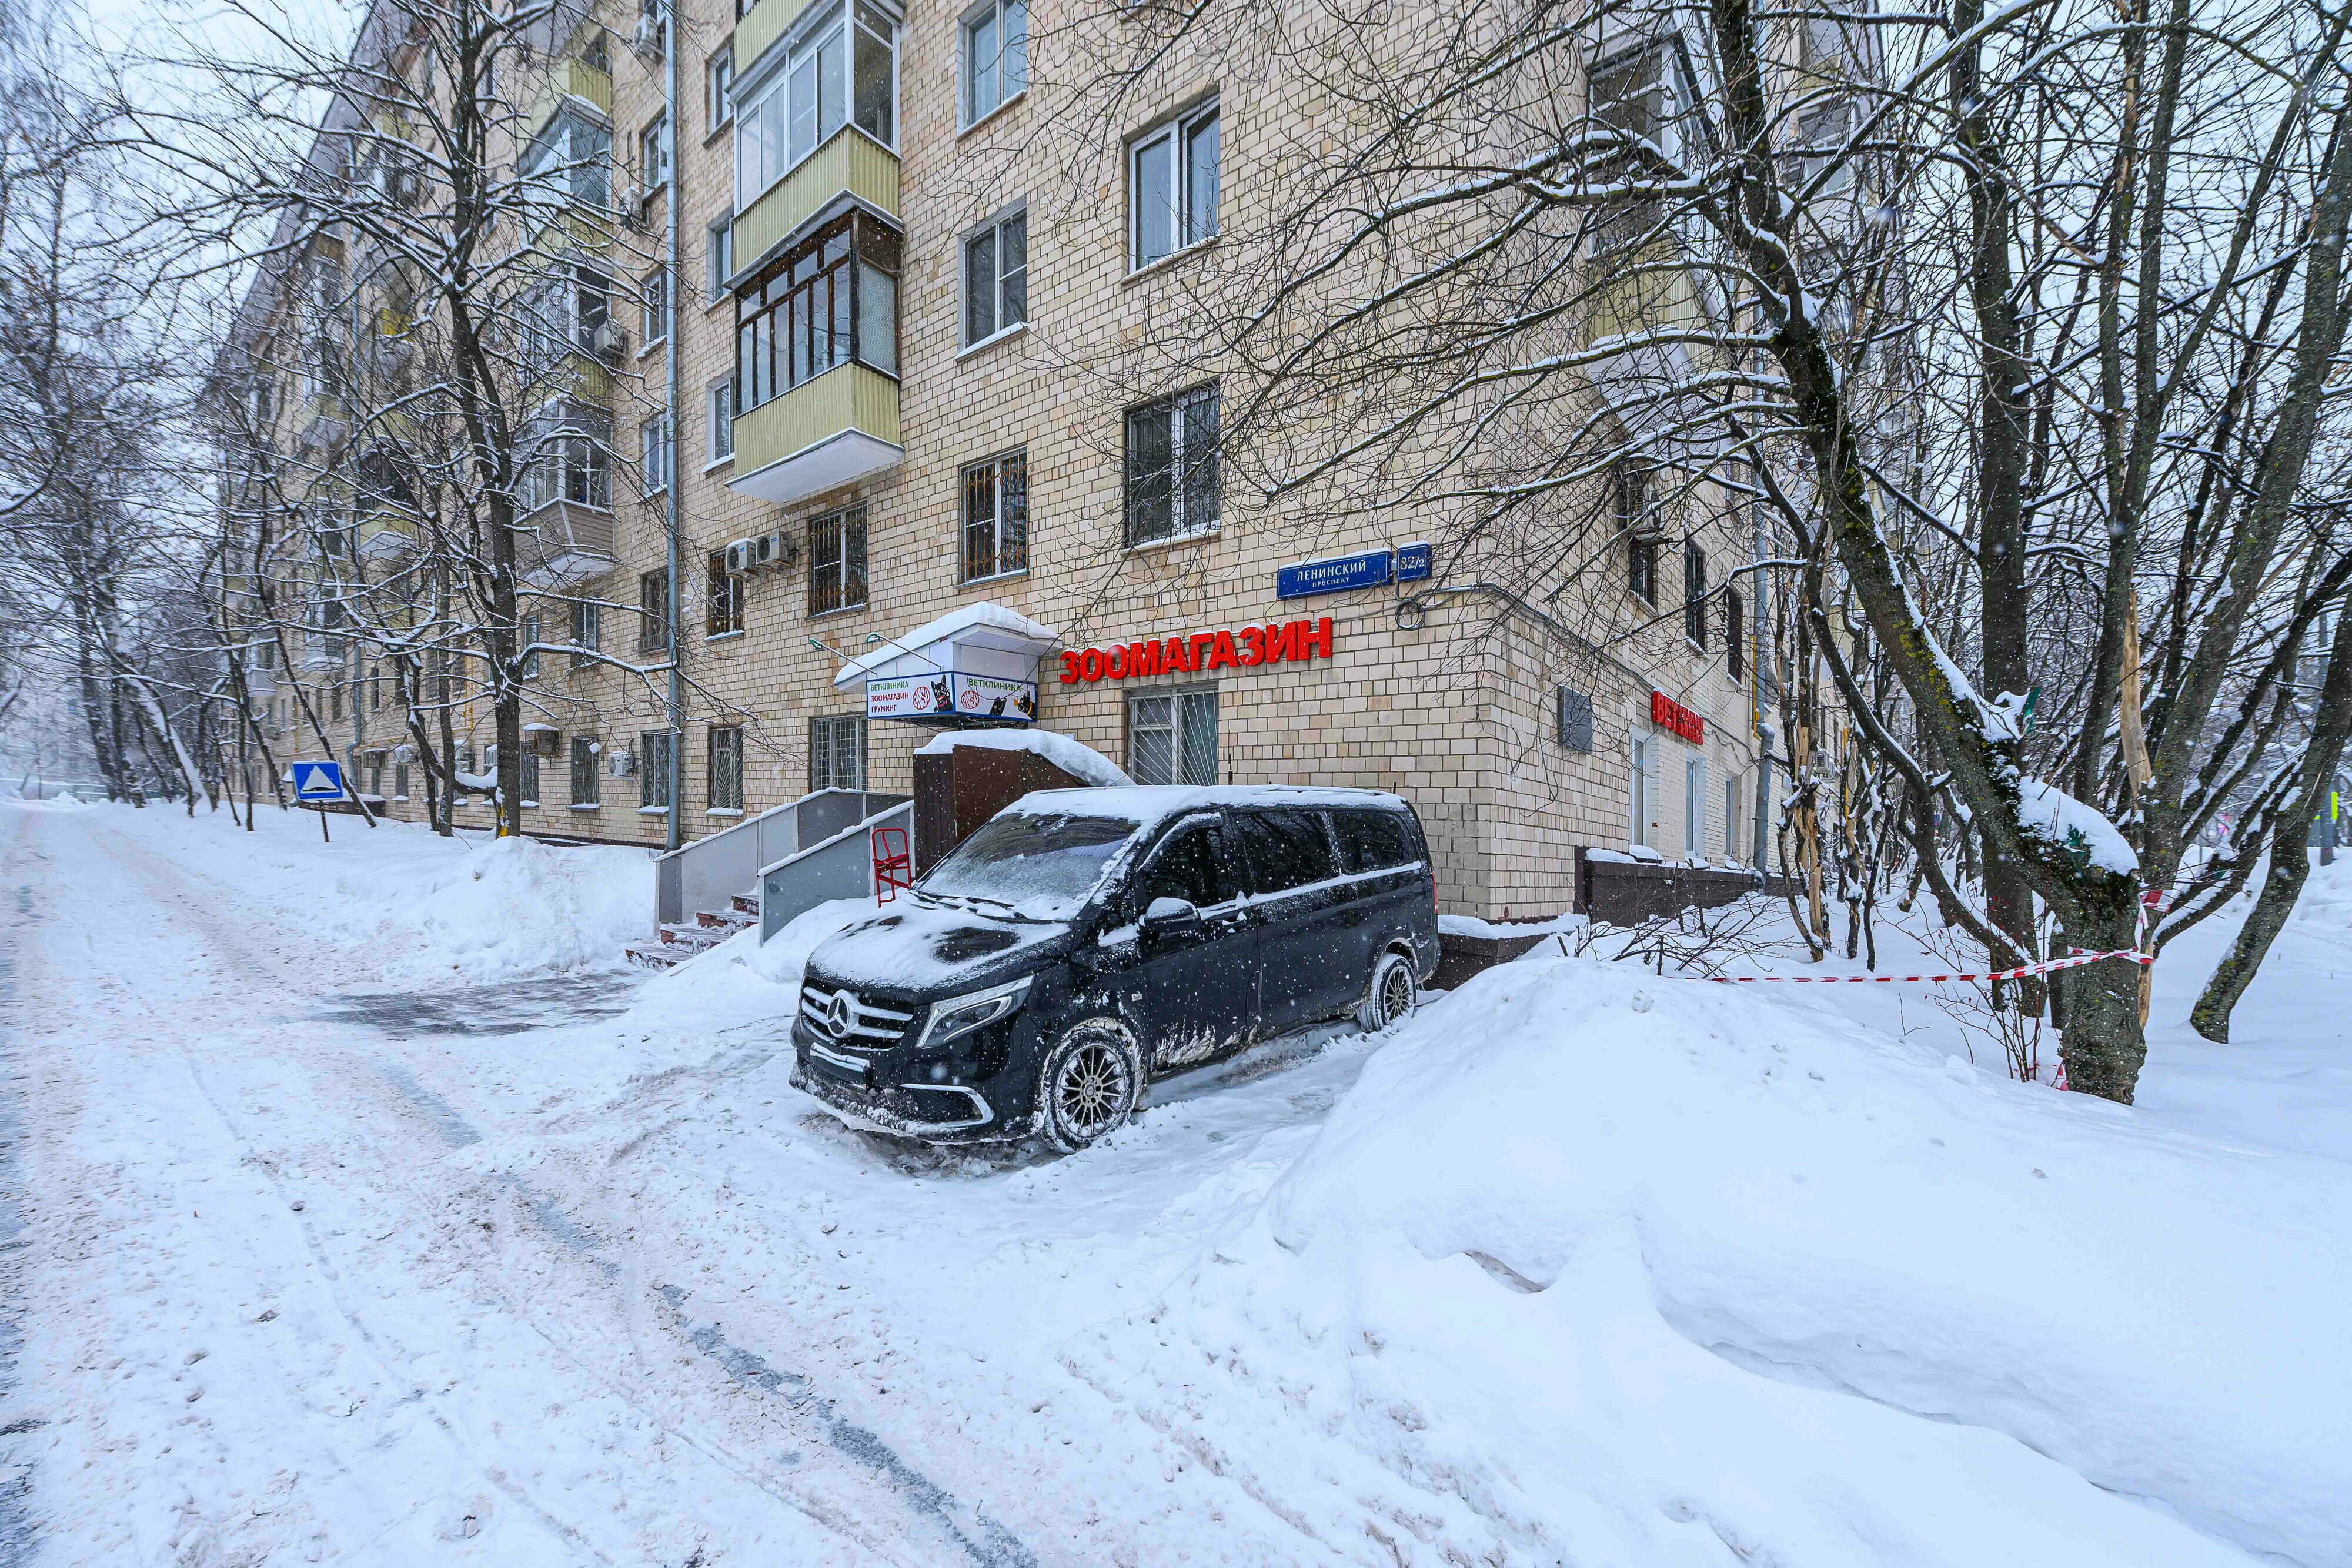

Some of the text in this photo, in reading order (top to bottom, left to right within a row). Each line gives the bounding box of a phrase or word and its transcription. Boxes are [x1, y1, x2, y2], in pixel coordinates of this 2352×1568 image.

[1297, 559, 1366, 581] ЛЕНИНСКИЙ
[1312, 577, 1350, 587] ПРОСПЕКТ
[1059, 617, 1333, 684] ЗООМАГАЗИН
[871, 681, 909, 691] ВЕТКЛИНИКА
[968, 678, 1021, 692] ВЕТКЛИНИКА
[871, 692, 909, 702] ЗООМАГАЗИН
[871, 704, 897, 713] ГРУМИНГ
